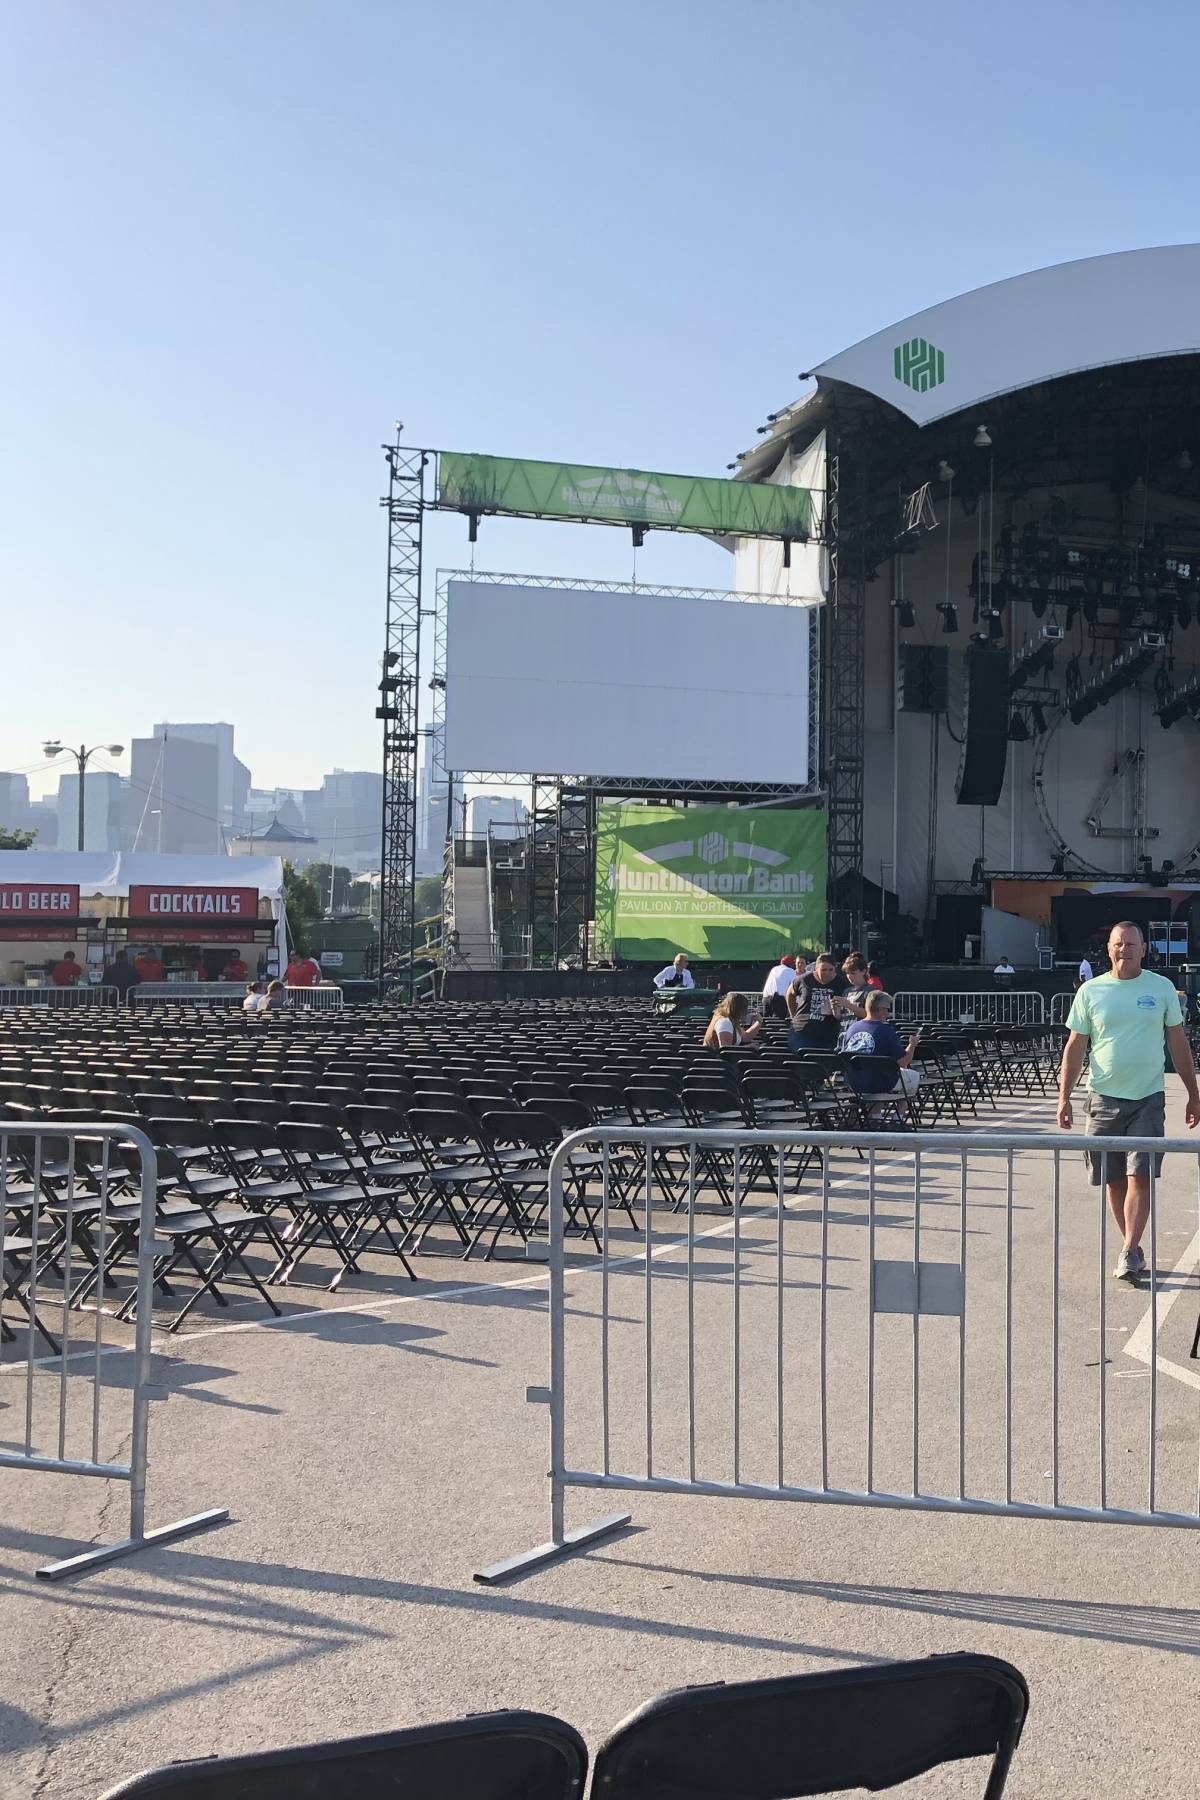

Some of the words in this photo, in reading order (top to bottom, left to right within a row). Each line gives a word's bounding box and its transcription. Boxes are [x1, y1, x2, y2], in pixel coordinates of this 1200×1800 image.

[609, 864, 748, 898] Huntington
[754, 867, 814, 892] Bank
[0, 892, 23, 909] LD
[28, 892, 71, 909] BEER
[149, 893, 241, 913] COCKTAILS
[619, 899, 672, 913] PAVILION
[675, 900, 688, 912] AT
[691, 900, 759, 913] NORTHERLY
[761, 902, 804, 913] ISLAND
